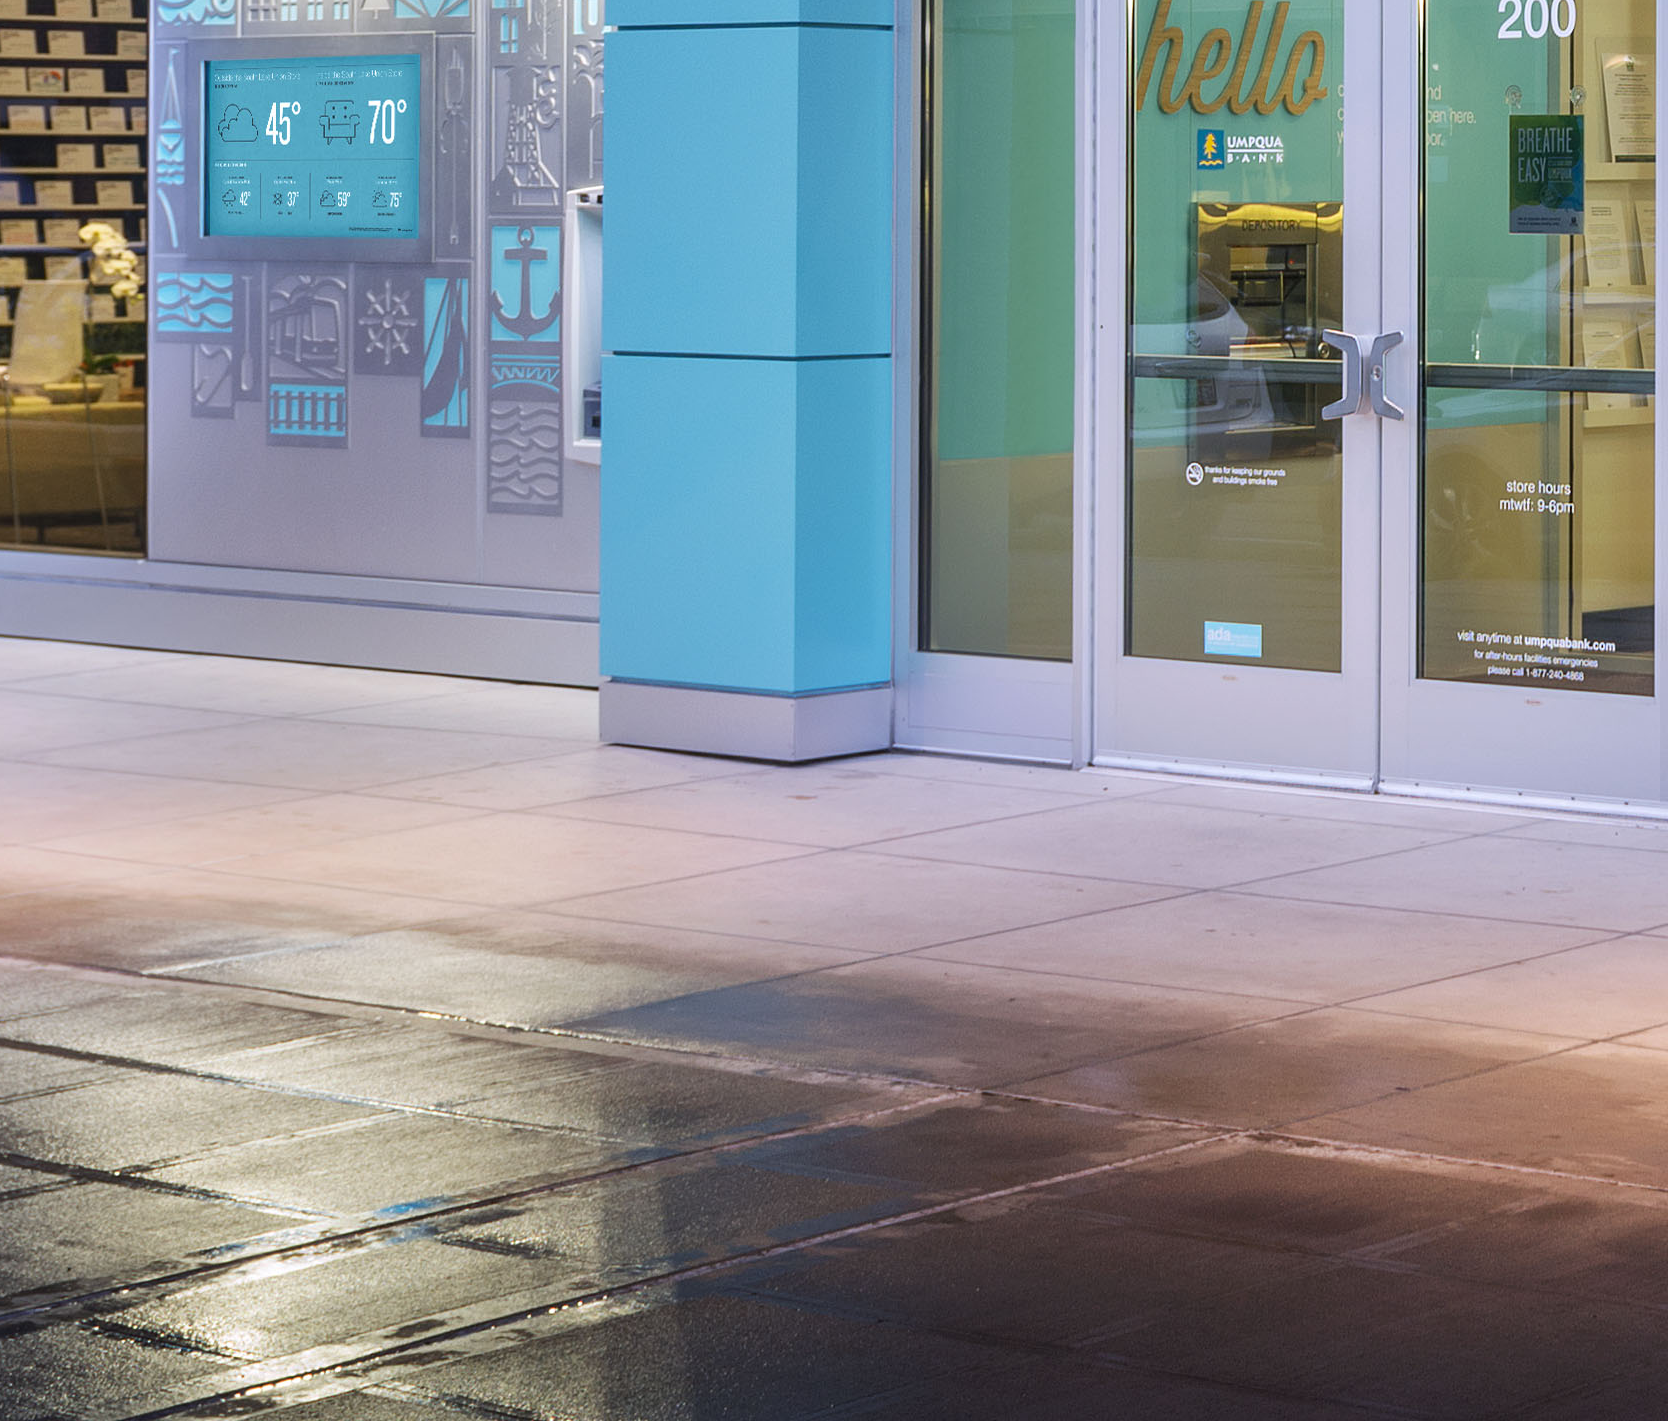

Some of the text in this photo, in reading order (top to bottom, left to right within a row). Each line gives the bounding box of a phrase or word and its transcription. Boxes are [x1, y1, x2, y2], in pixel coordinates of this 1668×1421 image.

[265, 101, 302, 145] 45°
[368, 99, 407, 145] 70°
[1227, 136, 1284, 148] UMPQUA
[1518, 127, 1573, 153] BREATHE
[1518, 157, 1547, 182] EASY
[1242, 219, 1301, 231] DEPOSITORY
[1506, 480, 1572, 495] store hours
[1537, 498, 1575, 516] 9-6pm
[1457, 629, 1616, 652] visit anytime at umpquabank.com
[1488, 665, 1510, 677] please
